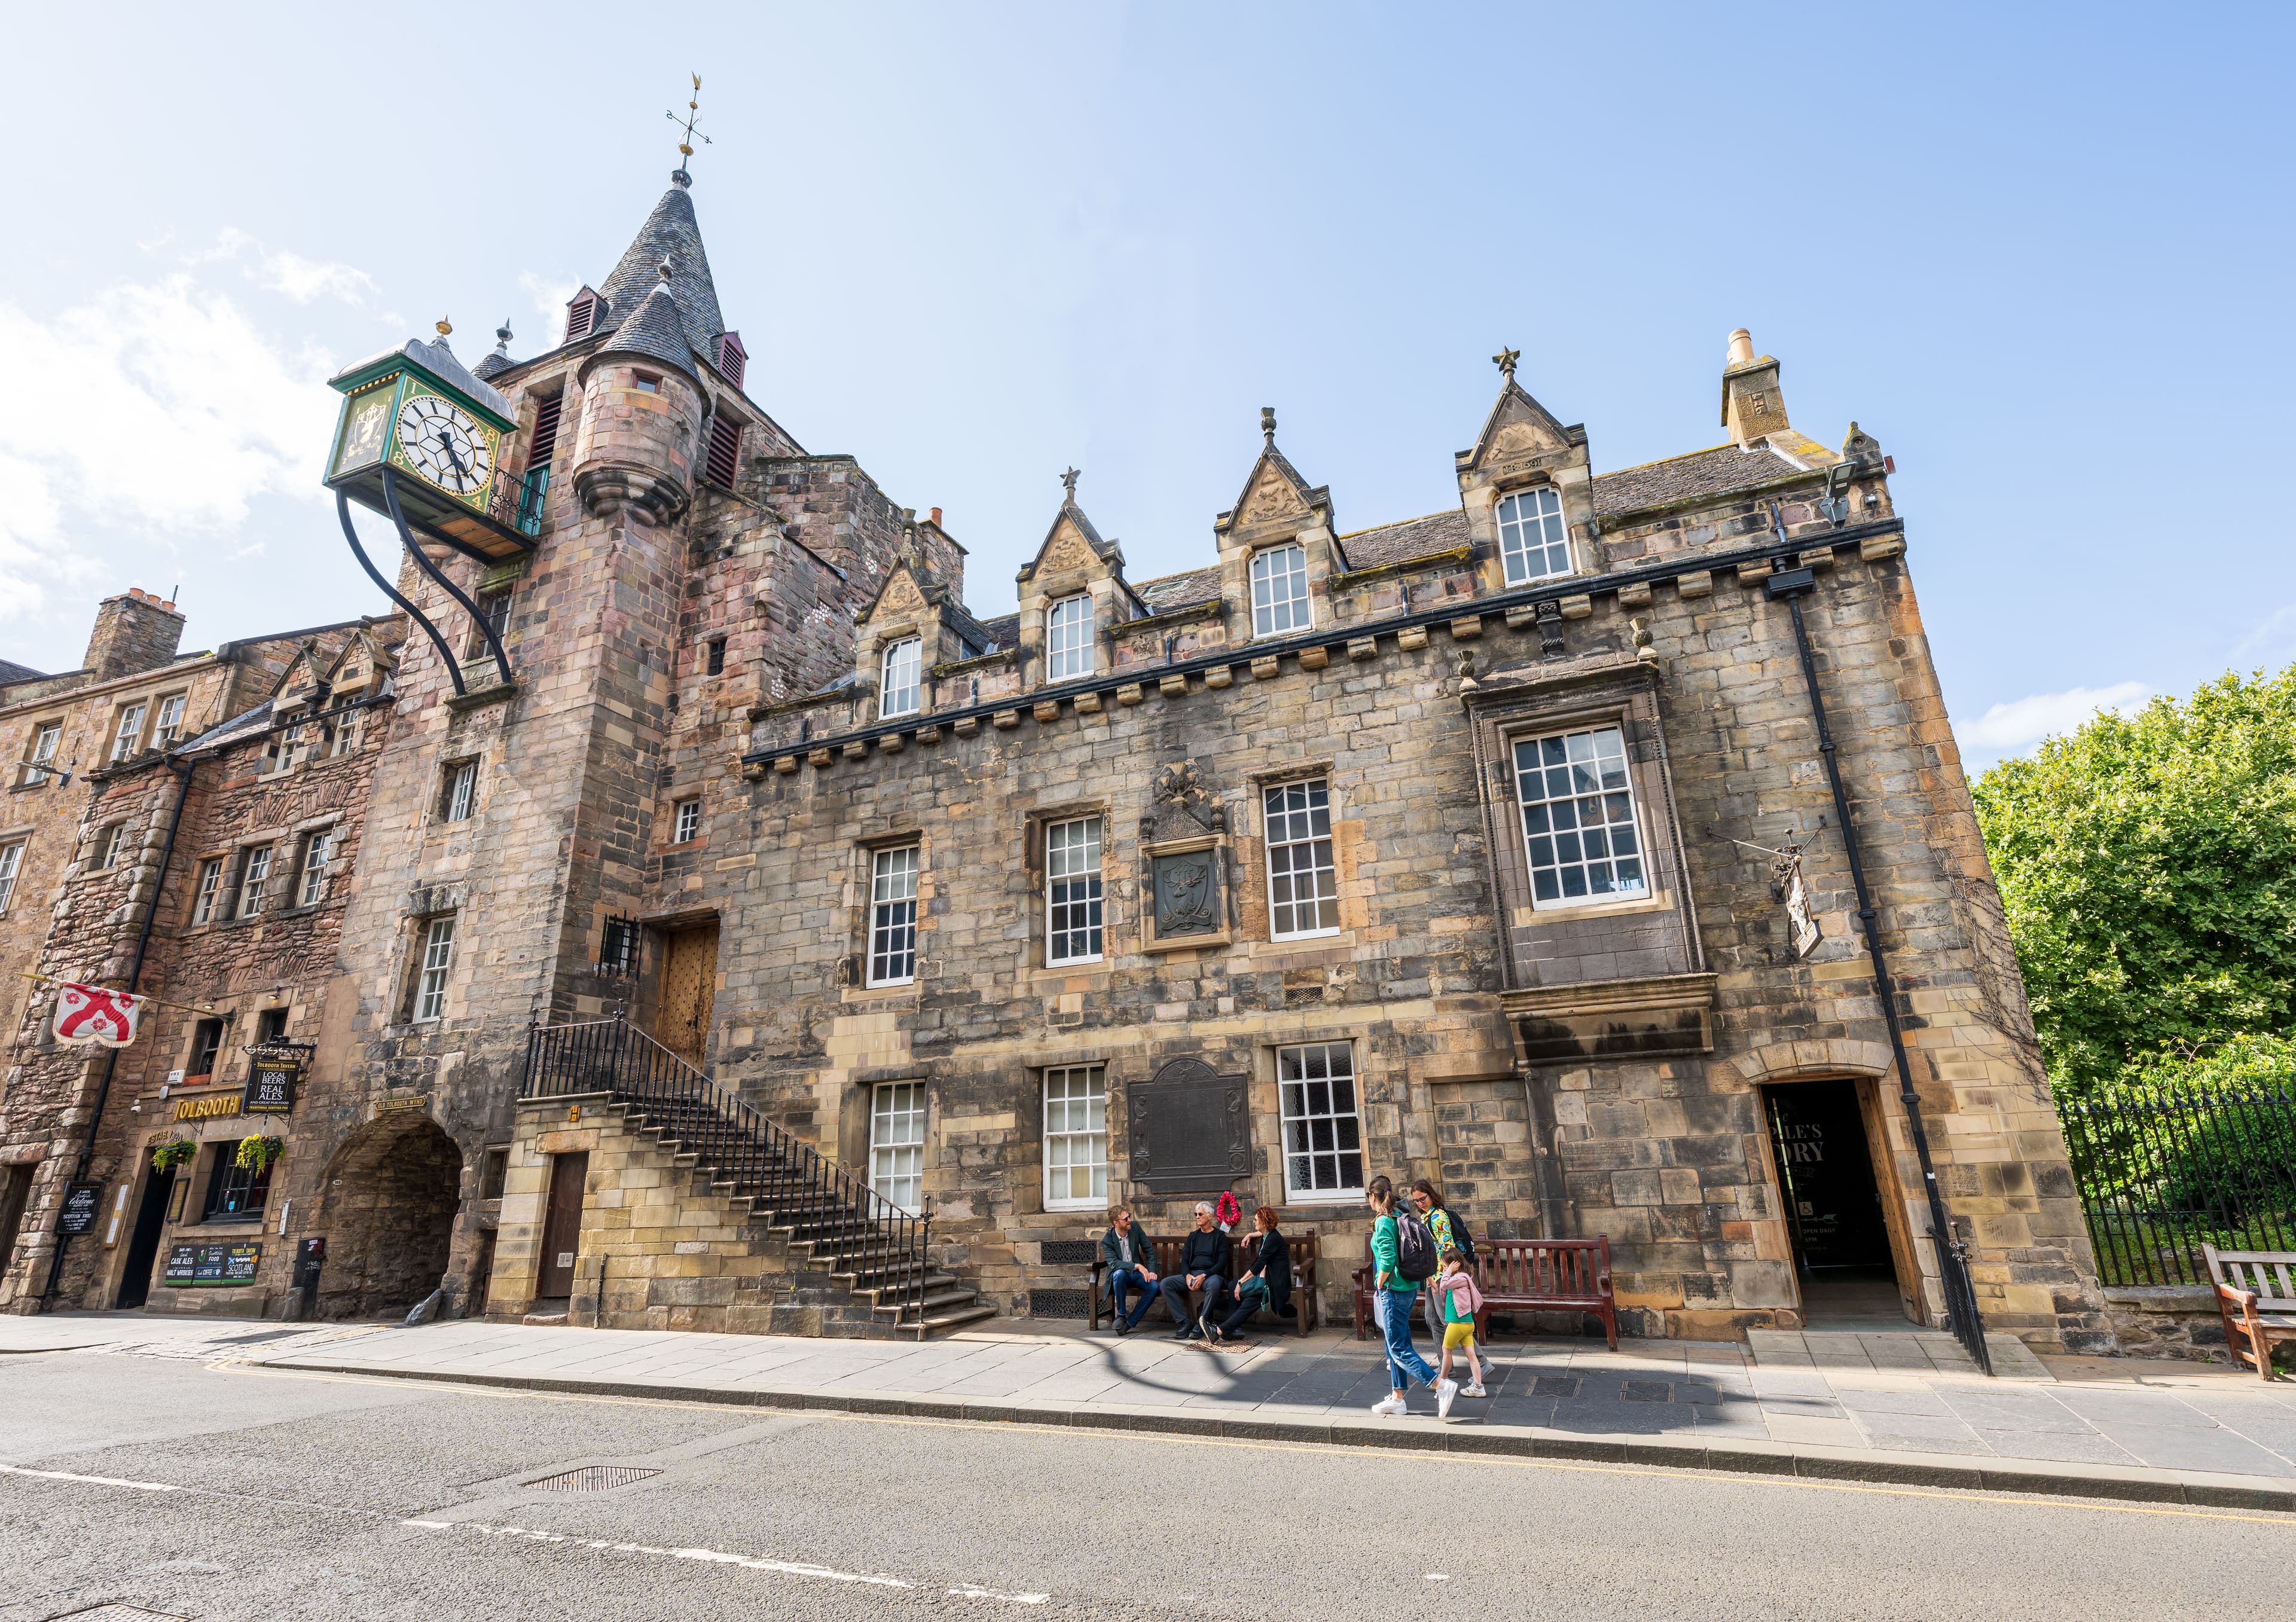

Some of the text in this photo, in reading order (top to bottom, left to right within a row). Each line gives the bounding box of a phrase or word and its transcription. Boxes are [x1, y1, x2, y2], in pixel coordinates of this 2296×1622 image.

[410, 382, 495, 442] 1 8
[393, 451, 483, 508] 8 4
[173, 1096, 242, 1122] TOLBOOTH
[228, 1263, 254, 1272] SCOTLAND
